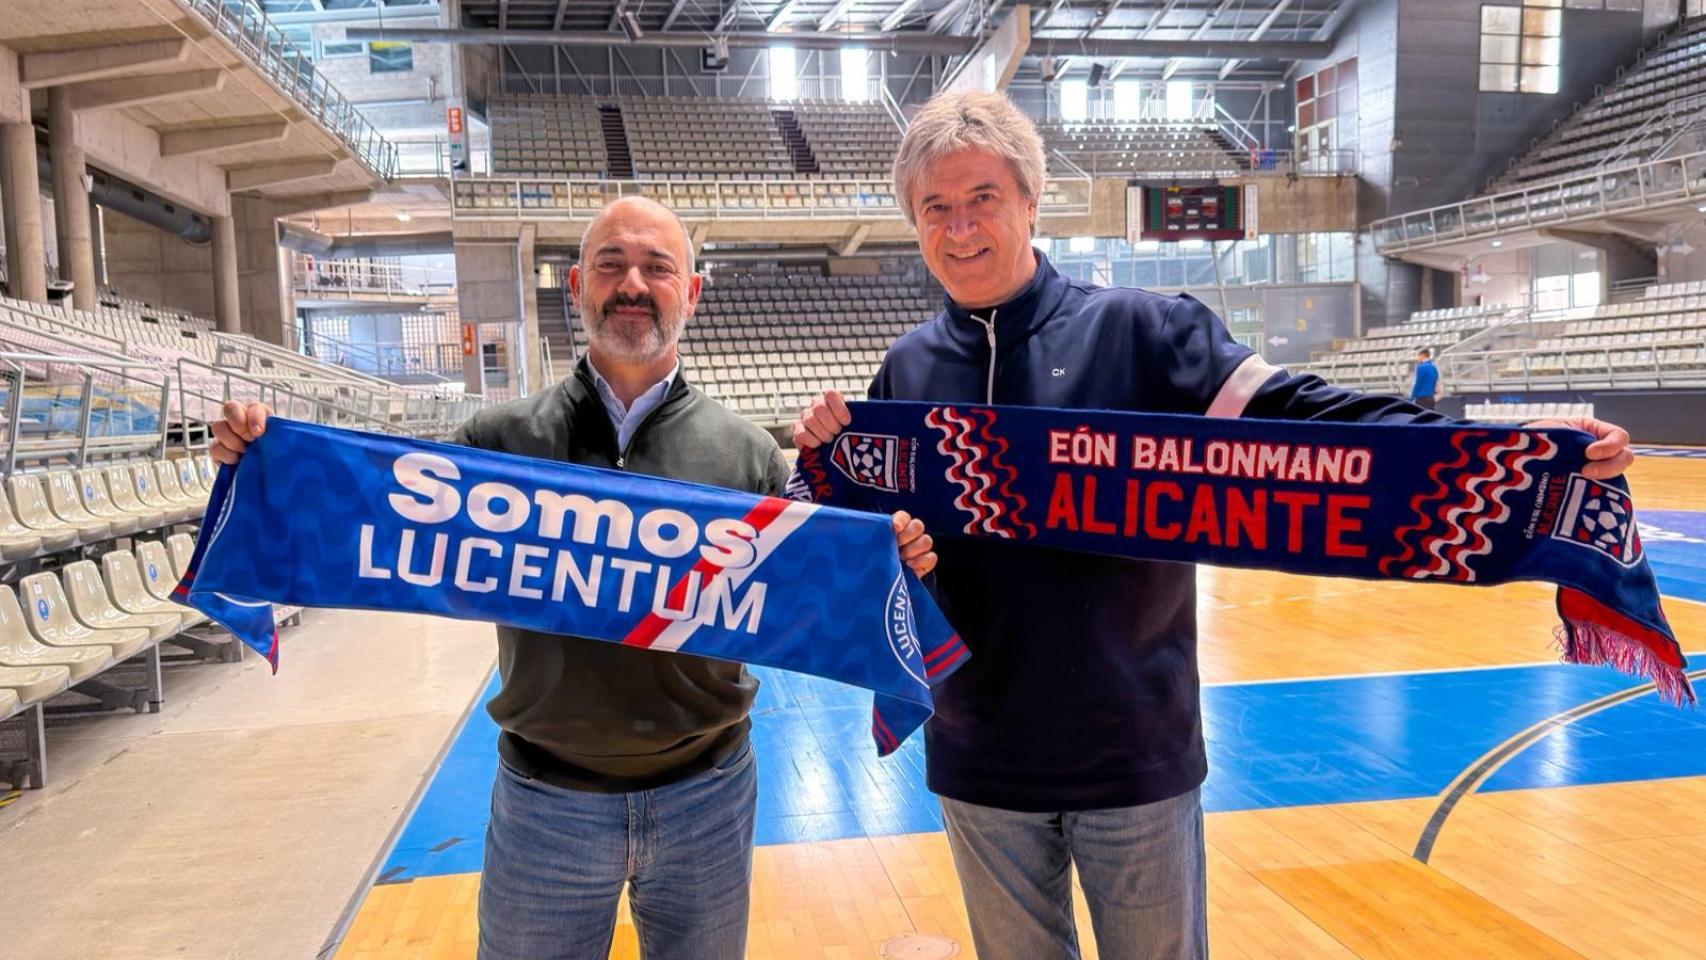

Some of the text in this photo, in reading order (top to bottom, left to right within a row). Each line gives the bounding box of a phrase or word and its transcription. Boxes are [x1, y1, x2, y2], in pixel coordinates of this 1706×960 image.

[1049, 425, 1372, 485] EÓN BALONMANO
[387, 452, 759, 569] Somos
[1045, 471, 1371, 558] ALICANTE
[358, 524, 768, 635] LUCENTUM
